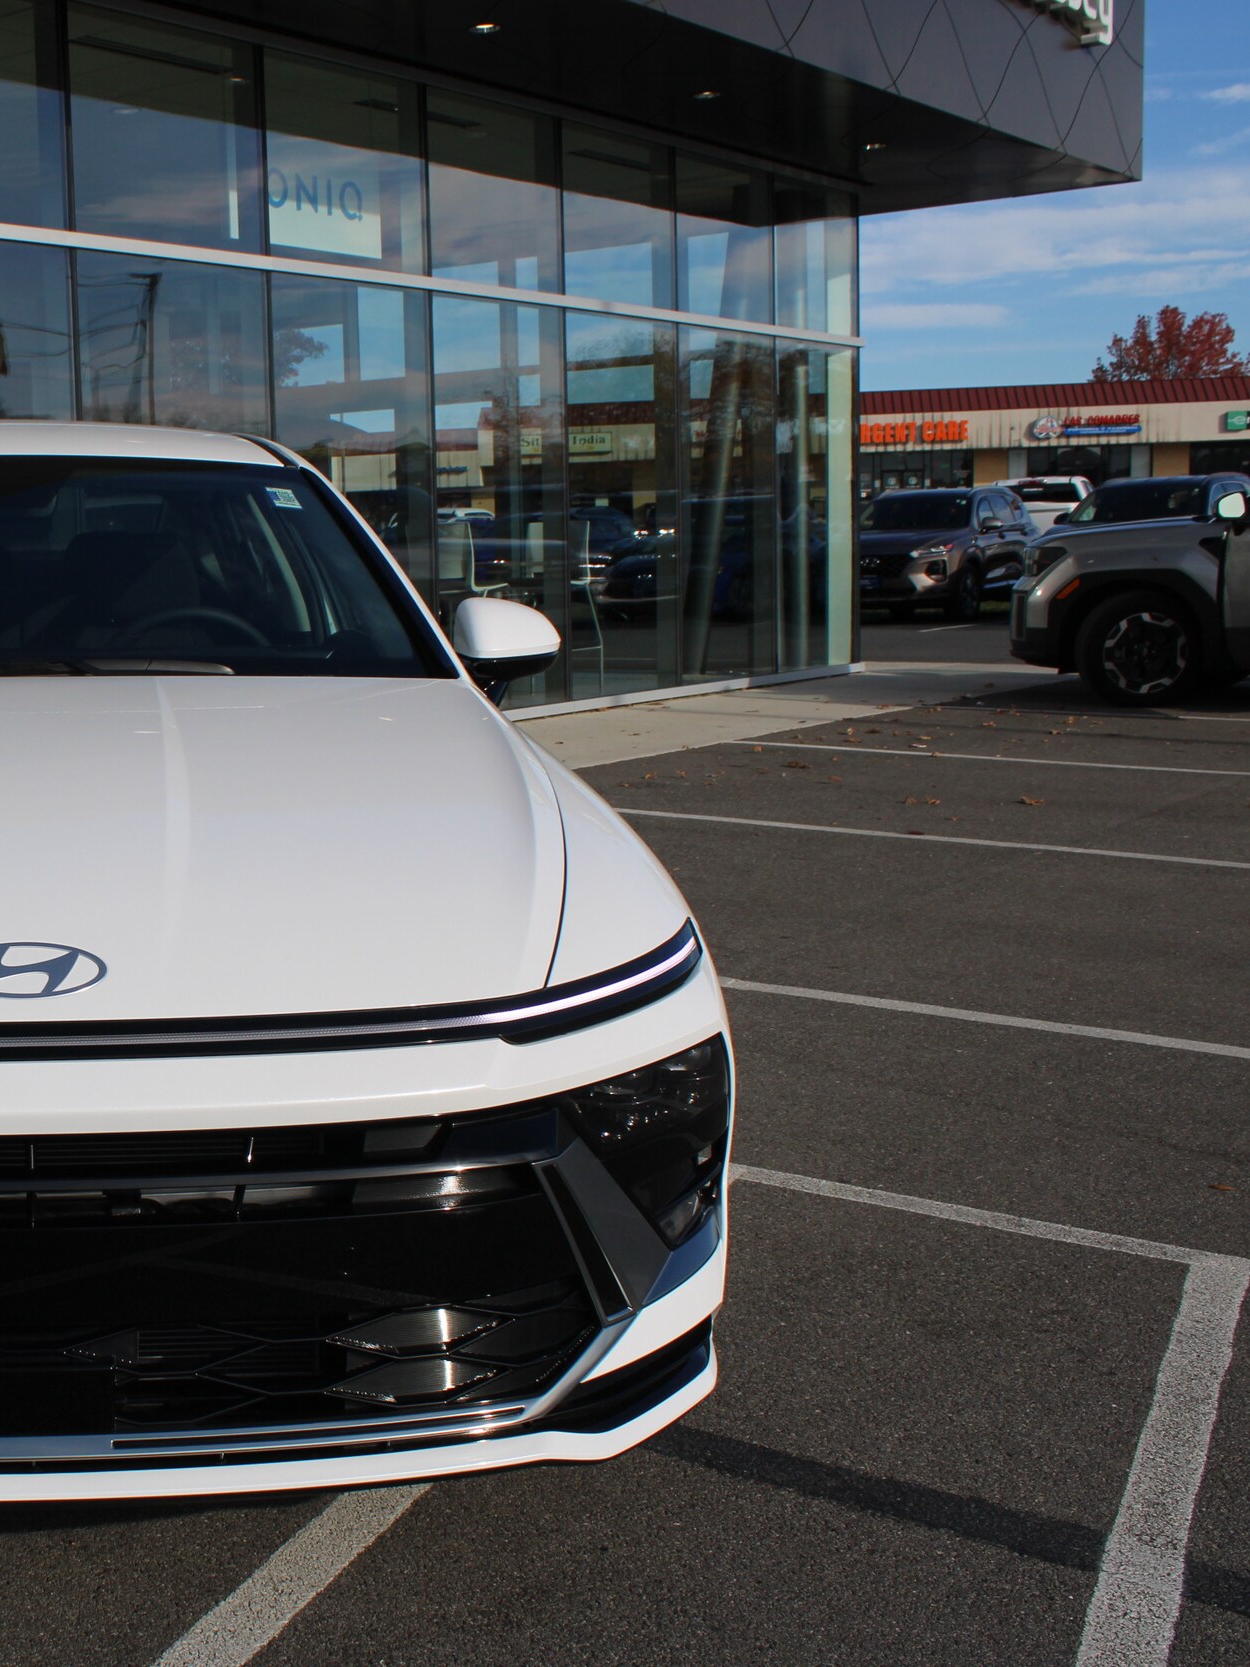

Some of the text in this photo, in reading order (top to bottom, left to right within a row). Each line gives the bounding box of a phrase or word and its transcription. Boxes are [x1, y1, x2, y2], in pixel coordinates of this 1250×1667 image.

[267, 167, 364, 222] ONIQ
[1087, 413, 1141, 425] COMADRES
[859, 420, 969, 443] RGENT CARE
[521, 434, 606, 448] Sit India
